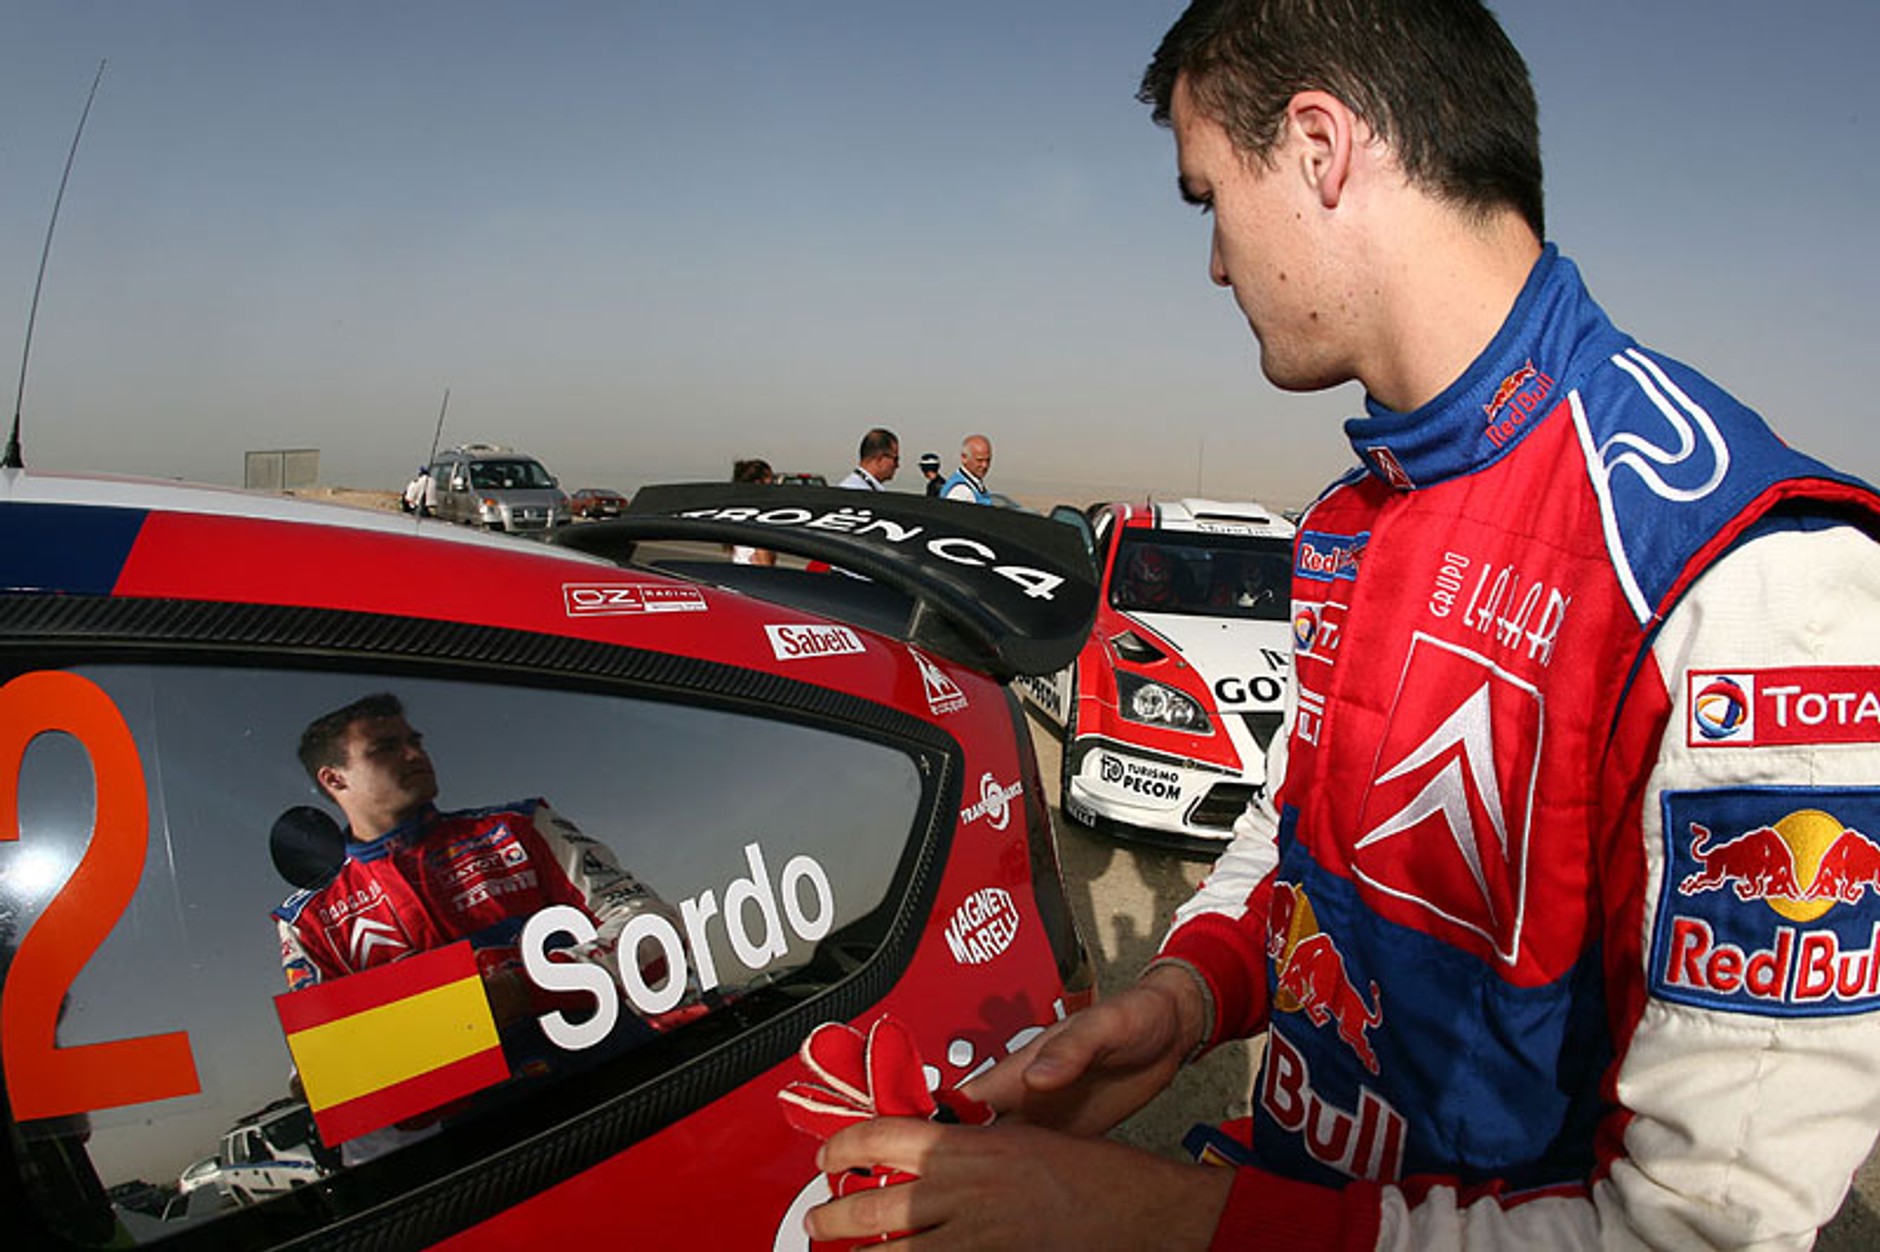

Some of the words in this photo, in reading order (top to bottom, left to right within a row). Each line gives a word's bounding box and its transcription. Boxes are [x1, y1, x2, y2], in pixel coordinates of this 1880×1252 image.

[1485, 401, 1527, 448] Red
[1516, 372, 1555, 413] Bull
[1301, 544, 1341, 573] Red
[572, 589, 636, 604] OZ
[1429, 552, 1470, 617] GRUPO
[777, 626, 856, 656] Sabelt
[1214, 676, 1287, 704] GO
[1123, 775, 1182, 800] PECOM
[1127, 763, 1179, 782] TURISMO
[0, 670, 203, 1123] 2
[521, 842, 834, 1050] Sordo
[1663, 915, 1796, 1002] Red
[1261, 1021, 1408, 1183] Bull
